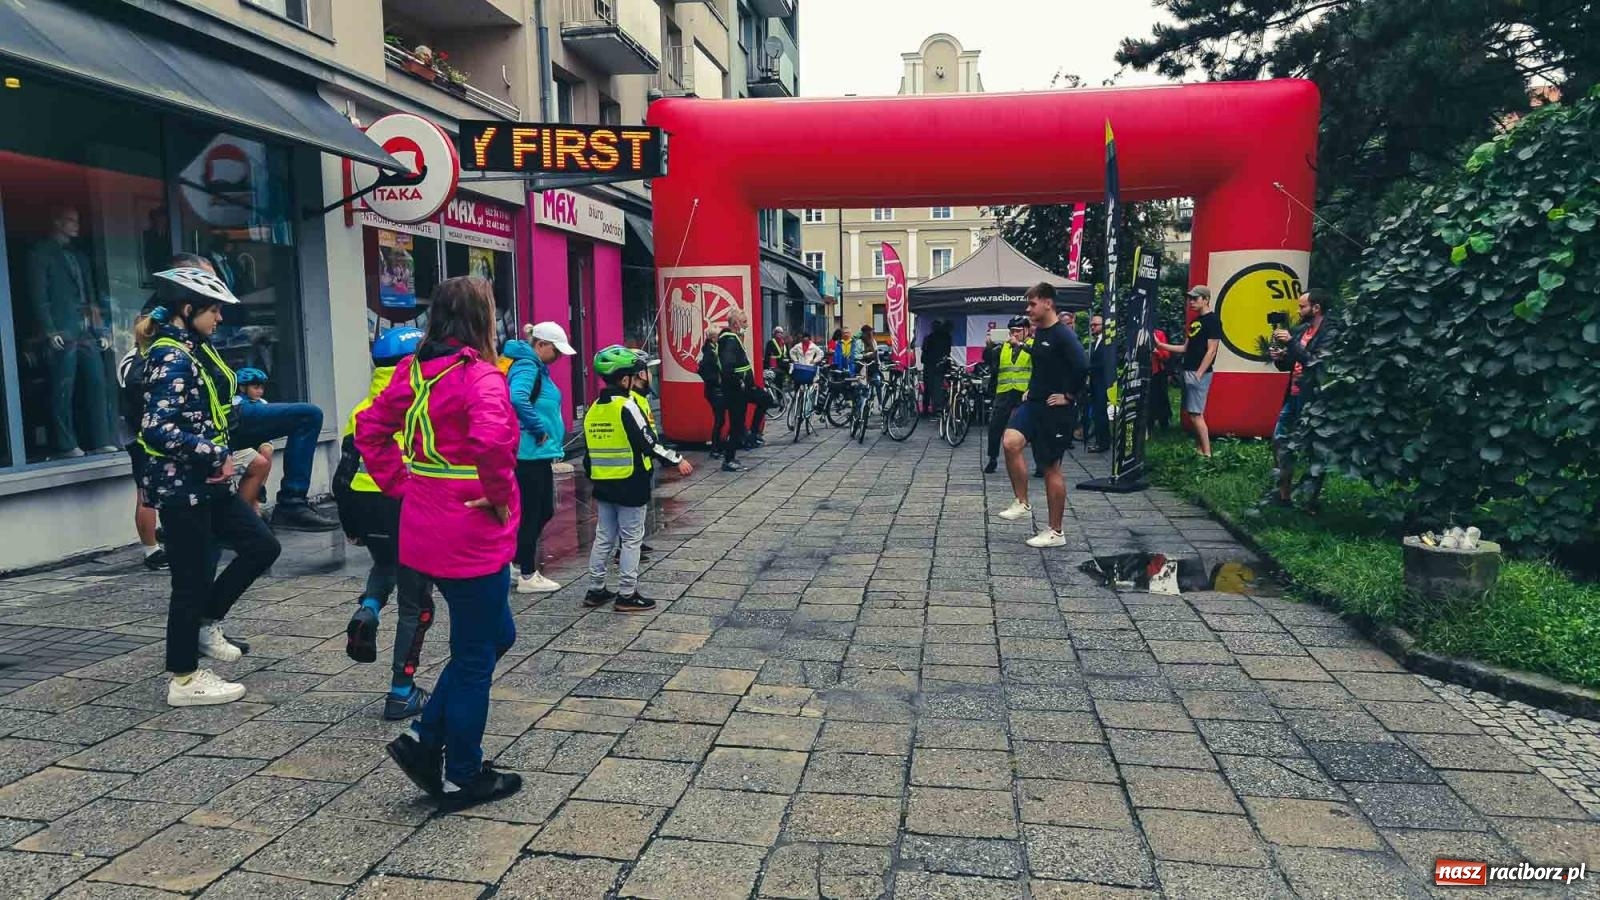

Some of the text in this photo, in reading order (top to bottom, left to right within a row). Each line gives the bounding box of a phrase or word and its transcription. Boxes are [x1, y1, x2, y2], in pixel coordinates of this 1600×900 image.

[474, 127, 651, 170] Y FIRST
[373, 187, 422, 201] ITAKA
[588, 204, 604, 220] biuro
[964, 293, 1029, 303] www.raciborz.
